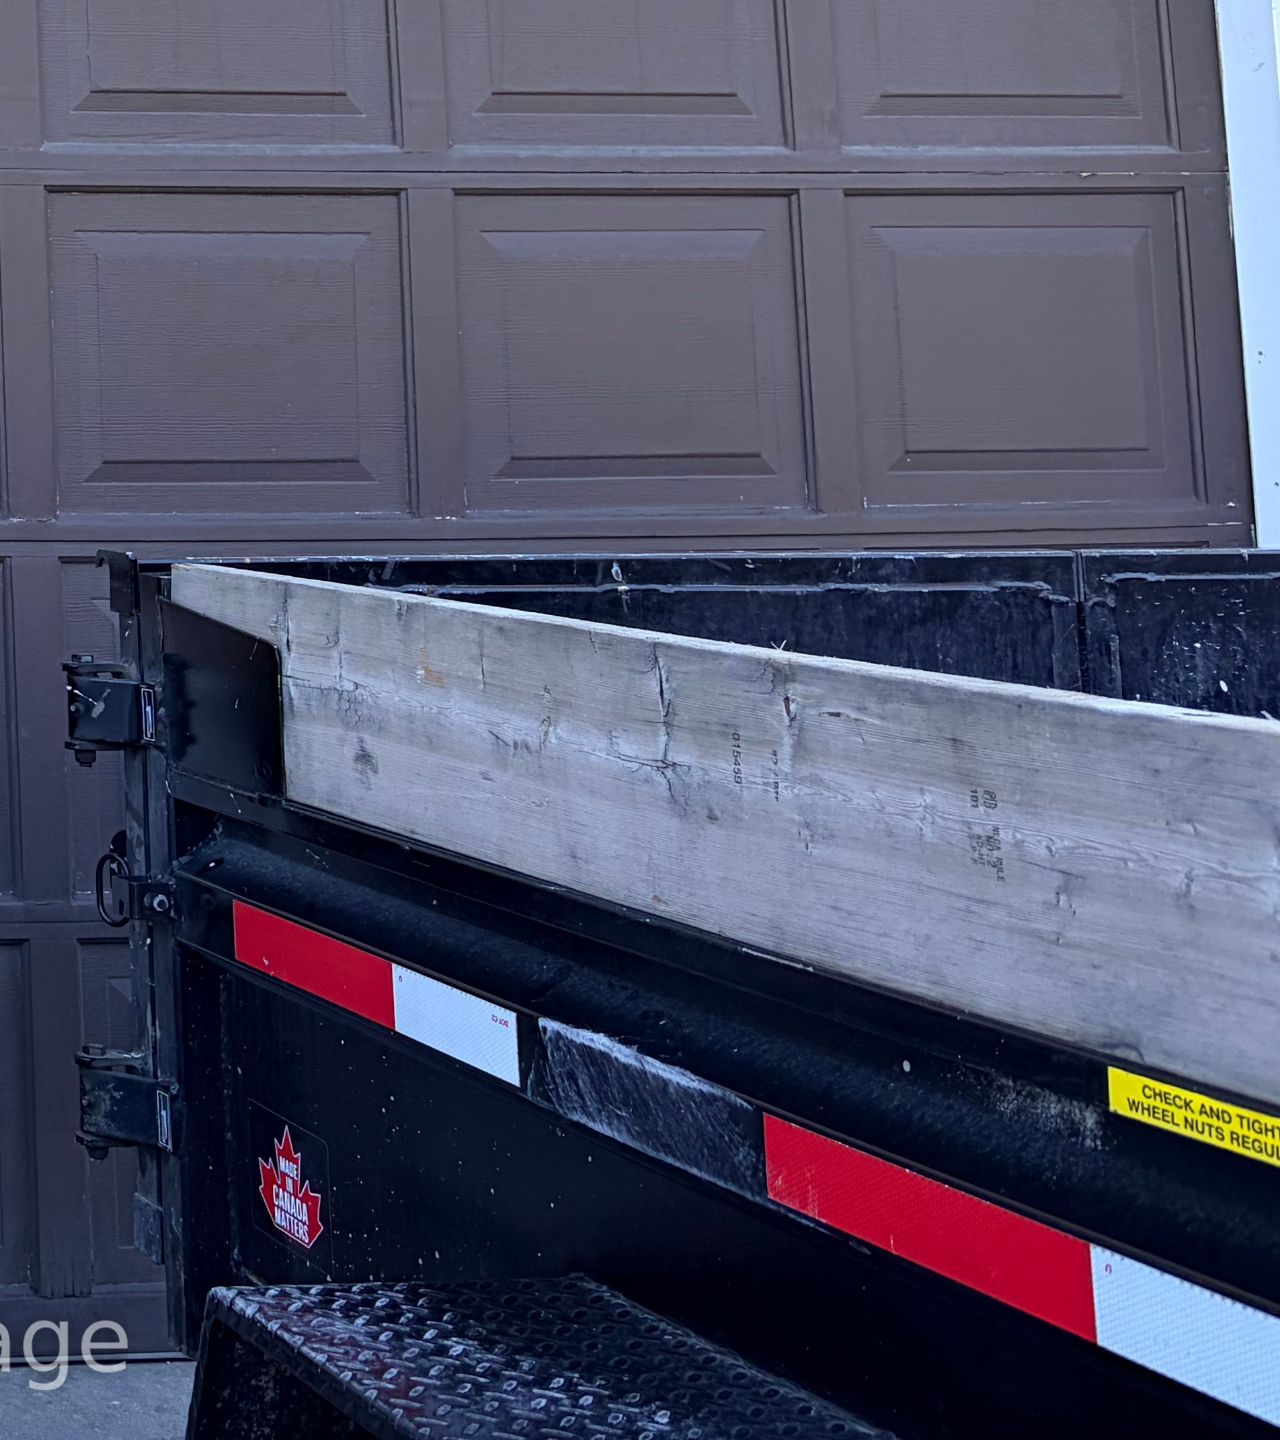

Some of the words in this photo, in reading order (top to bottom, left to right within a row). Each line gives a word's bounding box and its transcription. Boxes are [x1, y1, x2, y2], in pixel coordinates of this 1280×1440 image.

[1127, 1096, 1180, 1127] WHEEL
[1183, 1115, 1226, 1142] NUTS
[1141, 1084, 1195, 1114] CHECK
[1198, 1103, 1232, 1125] AND
[279, 1155, 298, 1180] MADE
[286, 1175, 294, 1195] IN
[273, 1183, 309, 1226] CANADA
[274, 1205, 309, 1243] MATTERS
